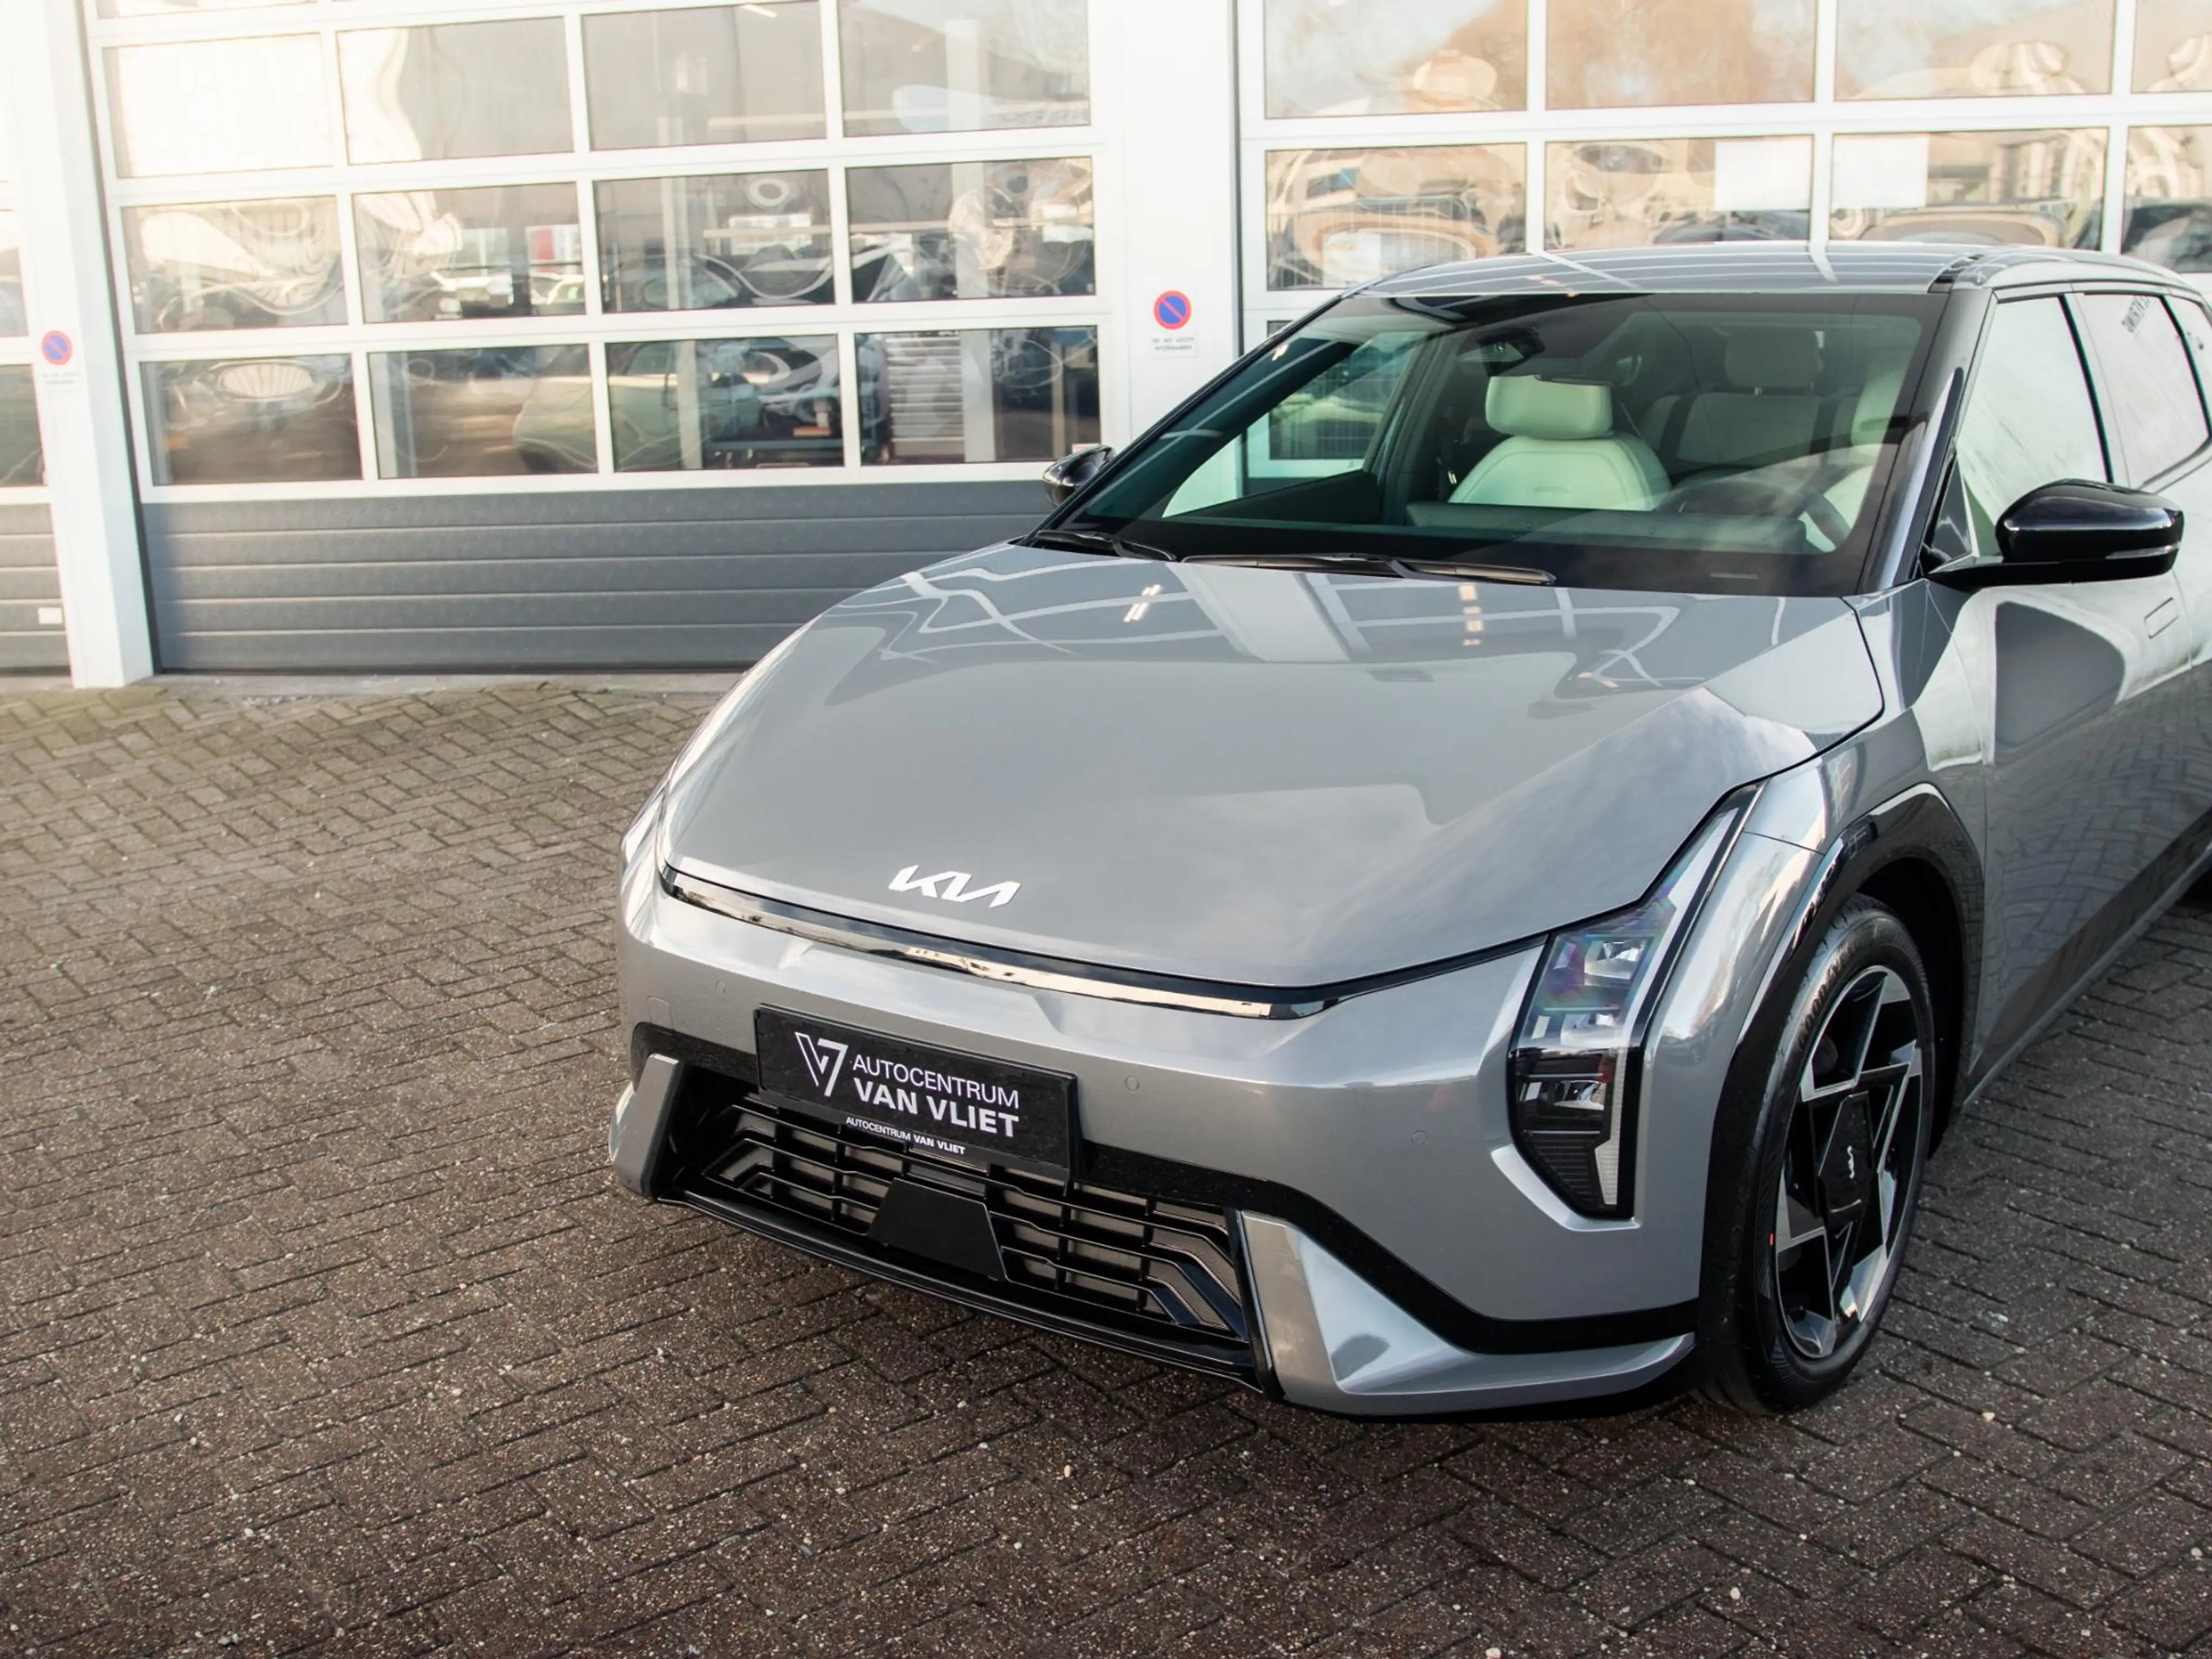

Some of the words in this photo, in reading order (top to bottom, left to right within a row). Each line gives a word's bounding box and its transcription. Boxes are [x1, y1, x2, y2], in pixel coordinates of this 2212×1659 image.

[853, 1054, 1019, 1109] AUTOCENTRUM
[853, 1077, 918, 1115] VAN
[926, 1094, 1019, 1138] VLIET
[846, 1116, 911, 1141] AUTOCENTRUM
[913, 1134, 934, 1147] VAN
[937, 1140, 966, 1155] VLIET
